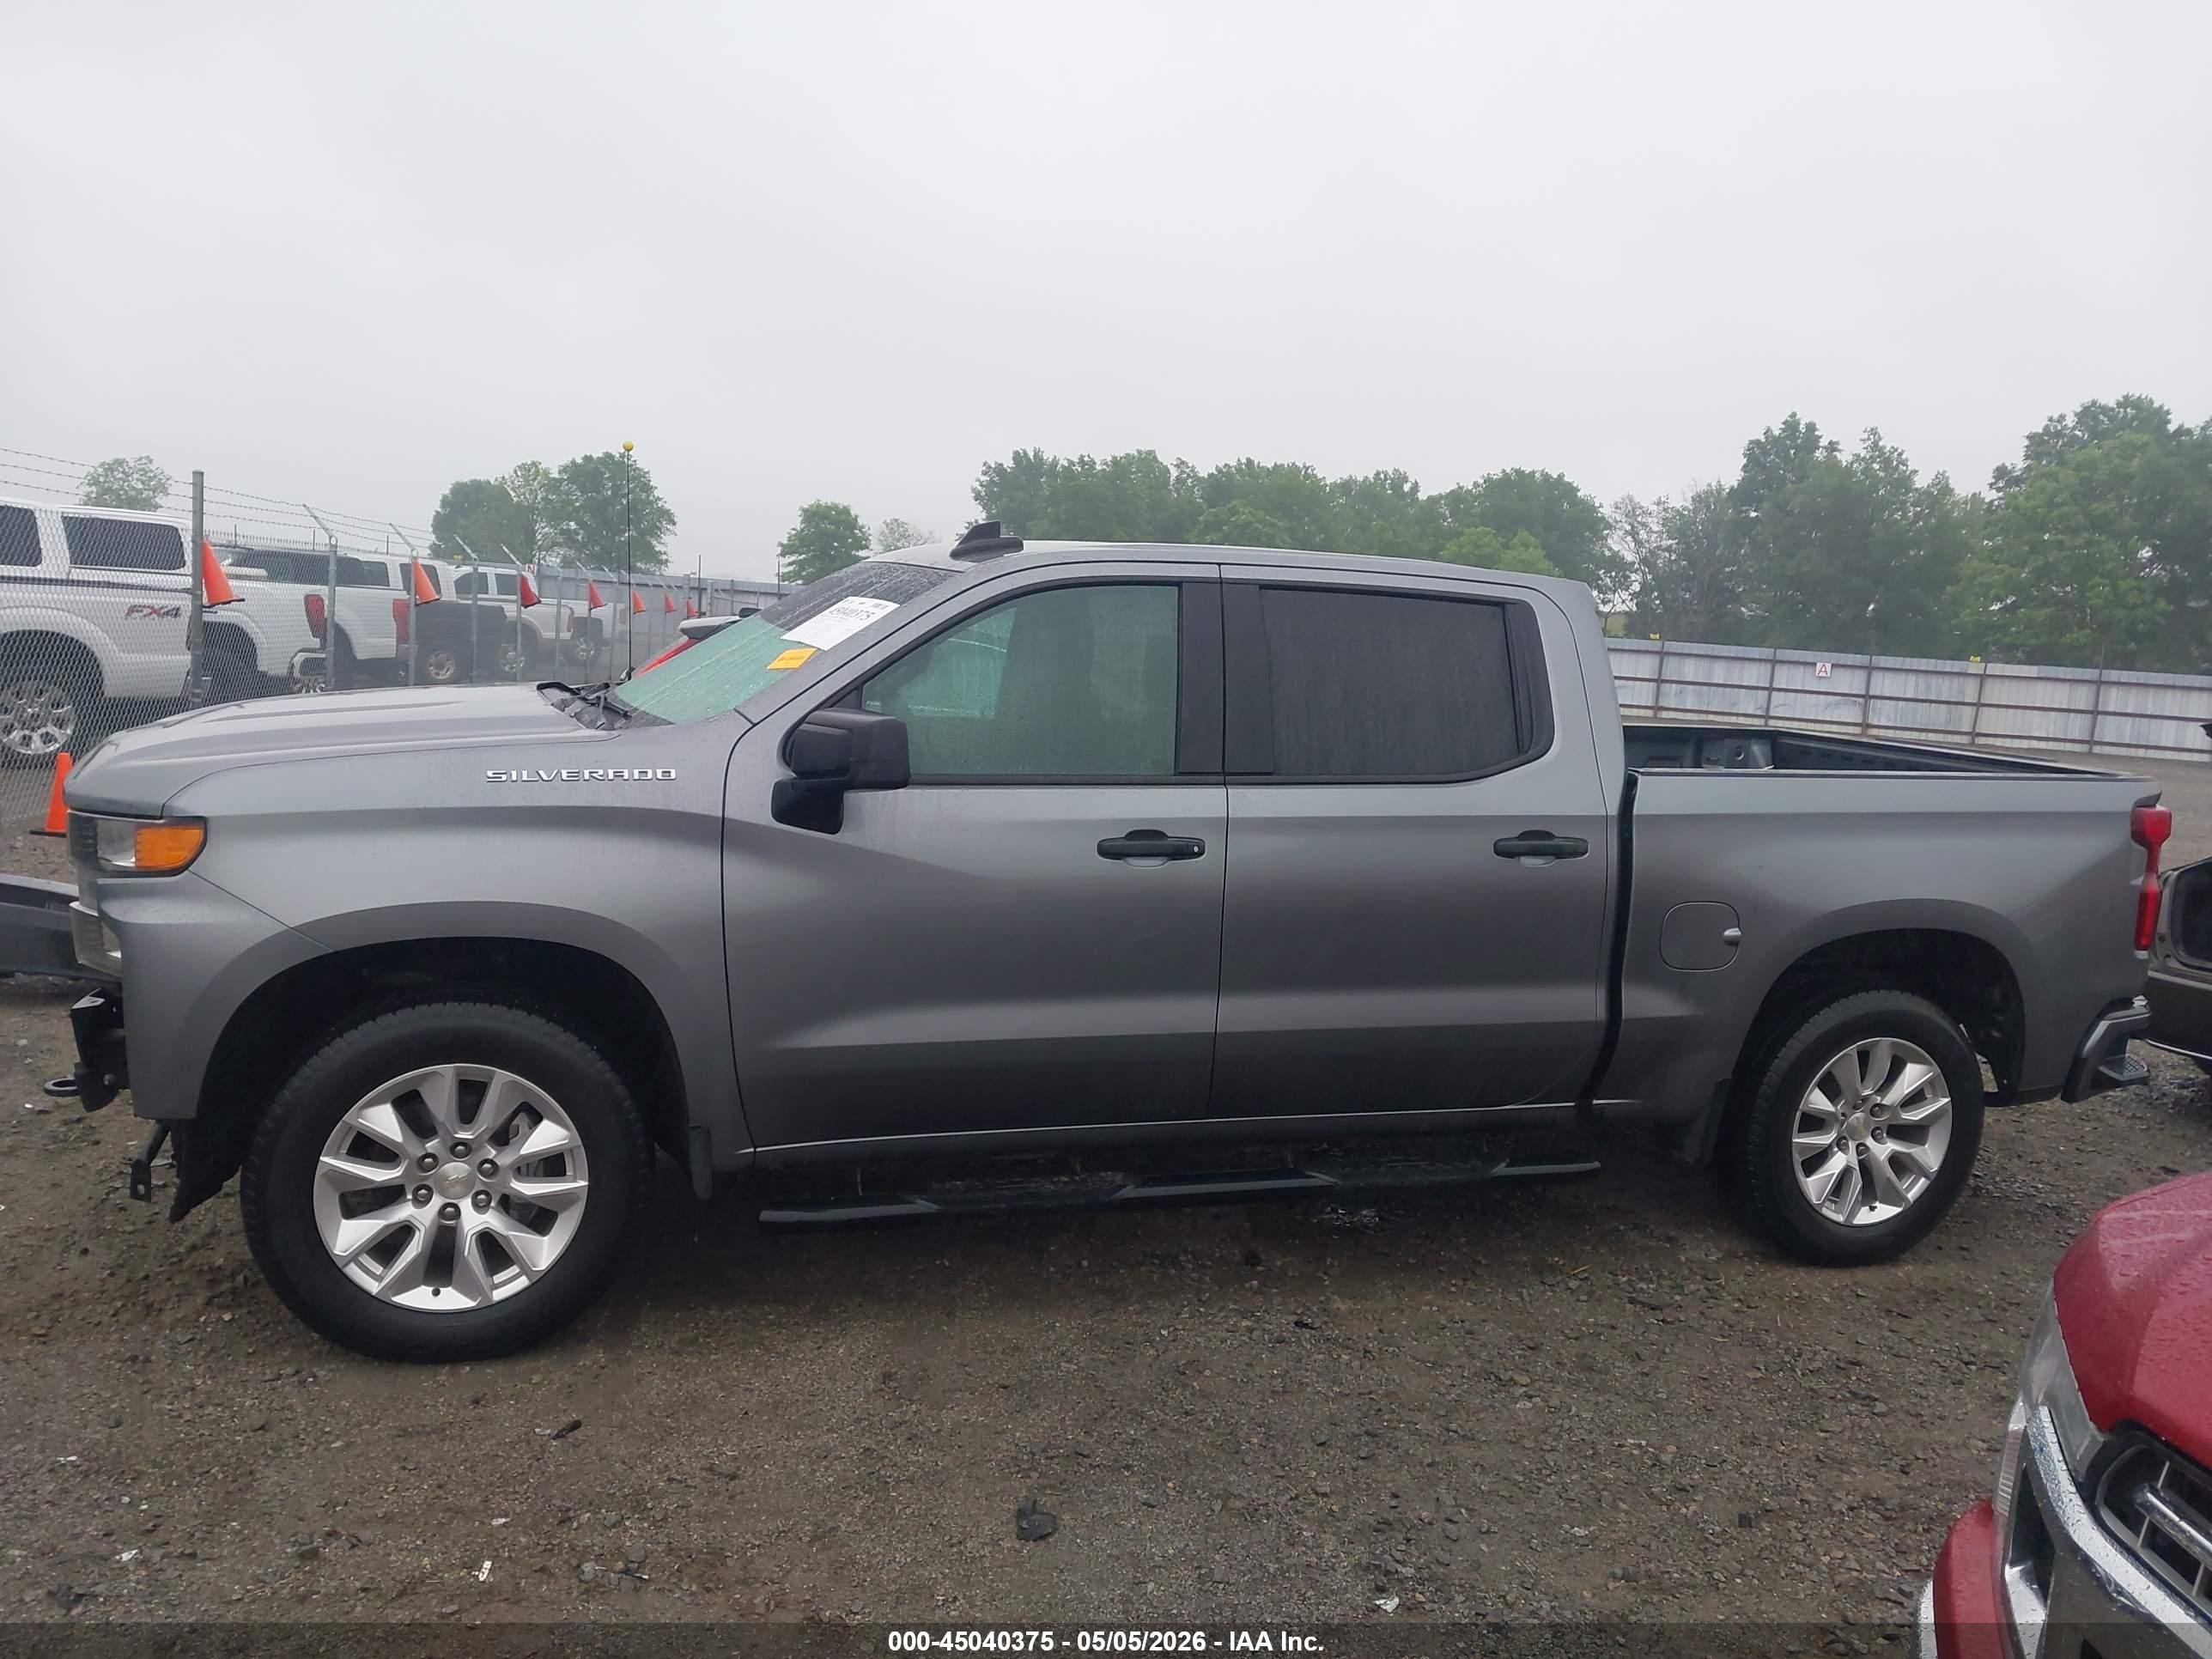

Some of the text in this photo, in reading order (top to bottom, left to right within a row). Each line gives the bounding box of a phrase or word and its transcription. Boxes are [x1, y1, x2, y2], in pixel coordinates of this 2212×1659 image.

[125, 604, 181, 619] FX4
[1817, 664, 1828, 676] A
[486, 768, 678, 782] SILVERADO
